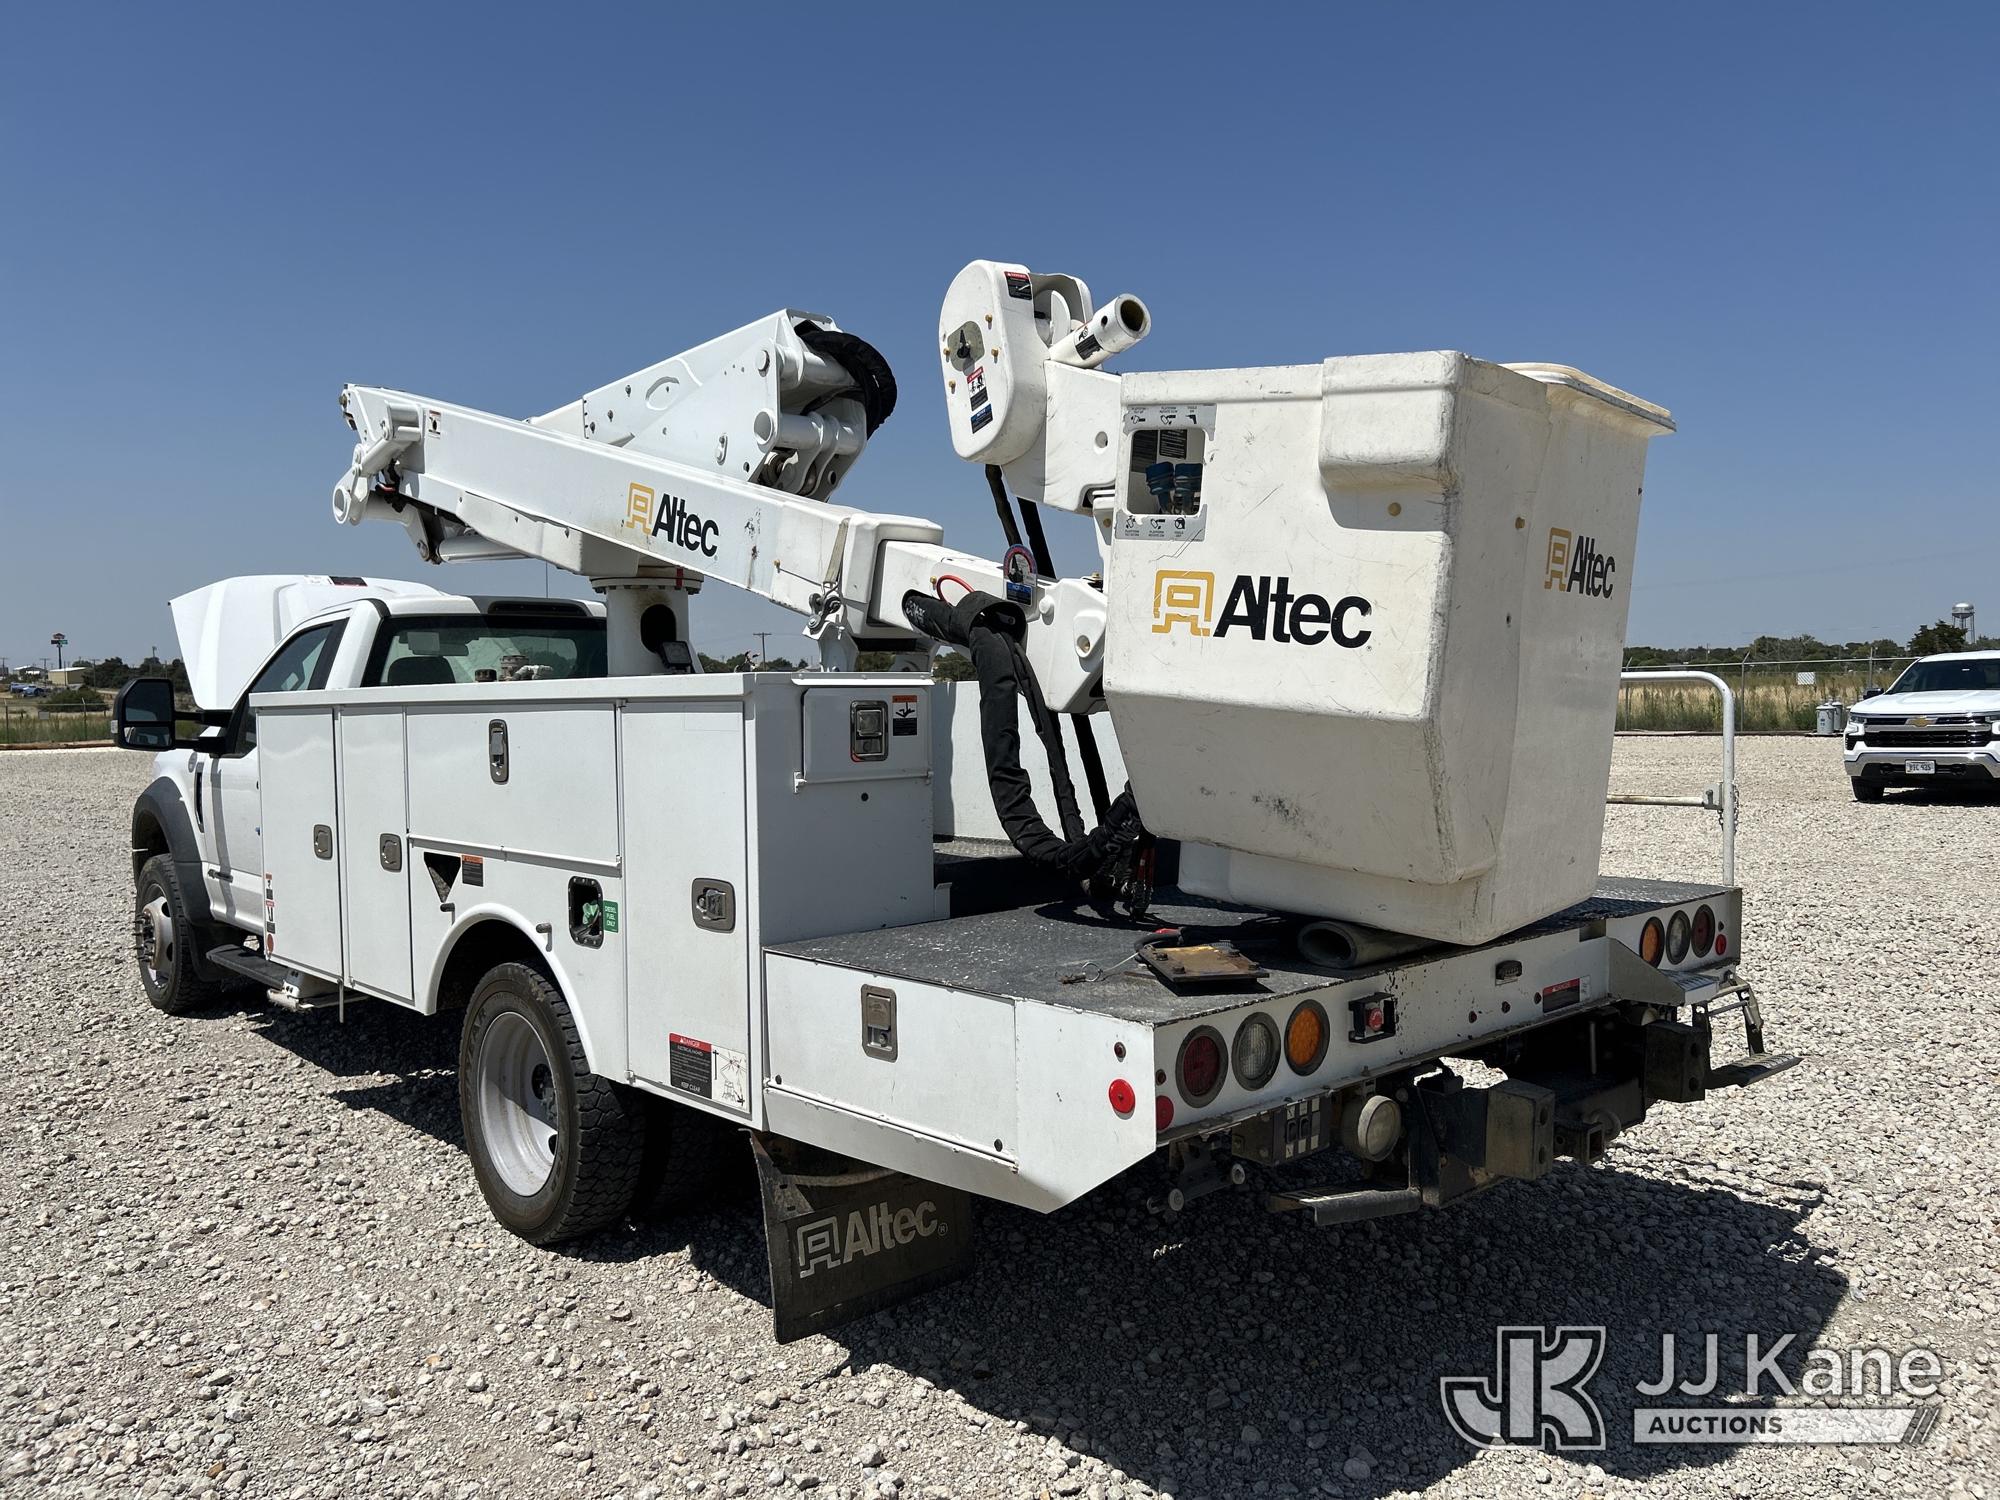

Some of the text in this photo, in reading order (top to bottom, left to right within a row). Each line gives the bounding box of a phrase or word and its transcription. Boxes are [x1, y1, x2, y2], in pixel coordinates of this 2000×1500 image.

[651, 493, 719, 558] Altec
[1566, 535, 1616, 599] Altec
[1213, 574, 1373, 649] Altec
[842, 1201, 938, 1264] Altec
